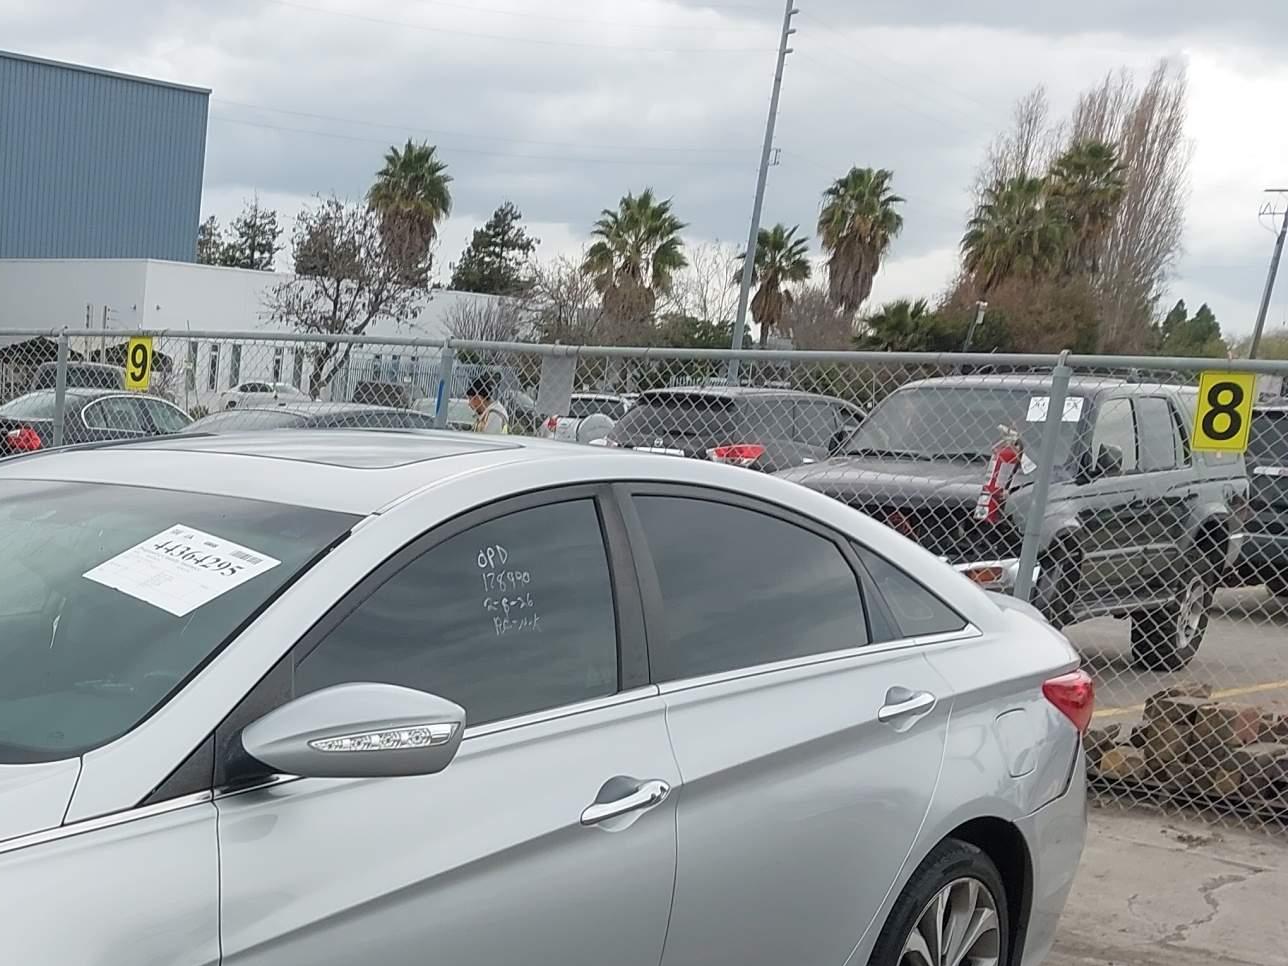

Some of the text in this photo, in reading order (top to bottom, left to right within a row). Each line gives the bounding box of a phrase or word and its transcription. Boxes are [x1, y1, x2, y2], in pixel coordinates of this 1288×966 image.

[130, 343, 149, 382] 9
[1201, 381, 1245, 441] 8
[154, 540, 244, 577] 44364295
[477, 544, 508, 569] OPD
